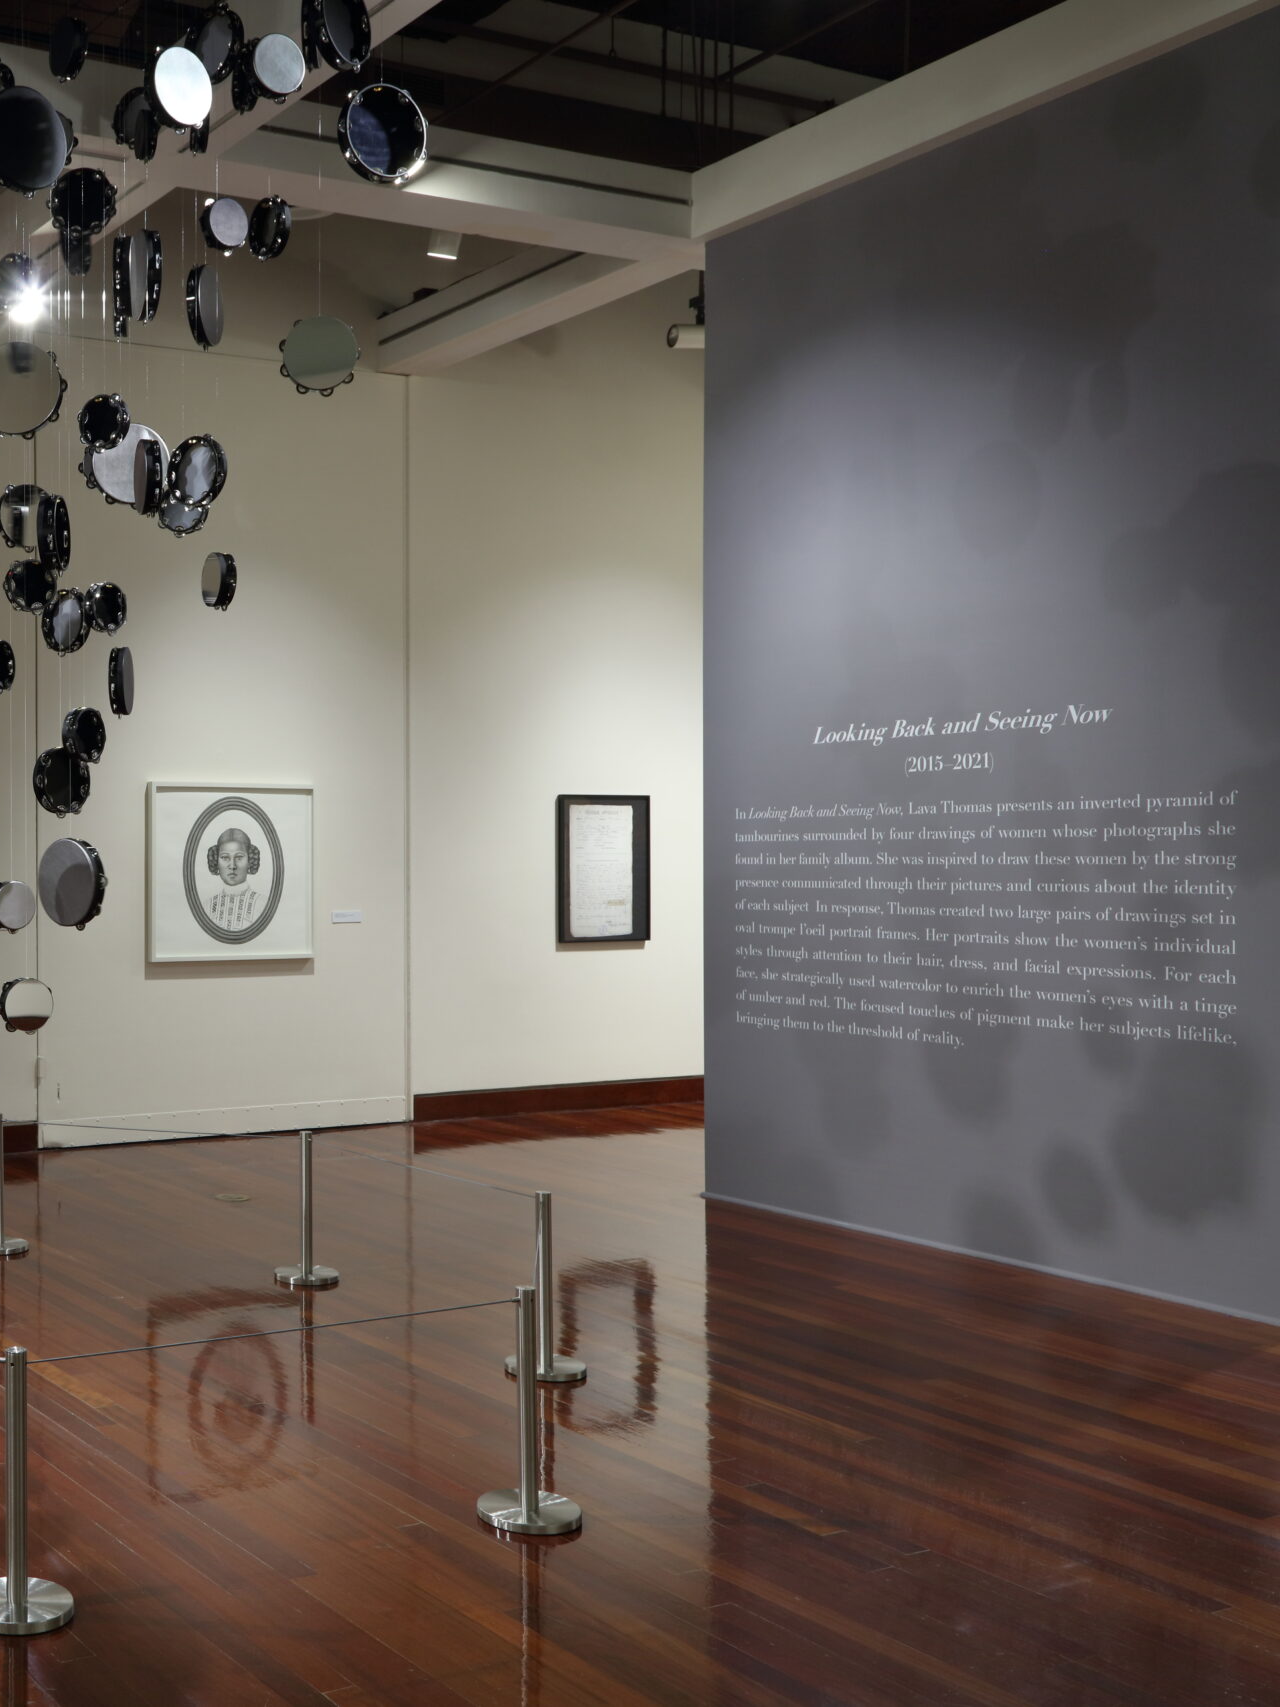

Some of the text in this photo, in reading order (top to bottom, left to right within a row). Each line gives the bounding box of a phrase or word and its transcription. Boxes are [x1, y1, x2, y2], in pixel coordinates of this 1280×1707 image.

[813, 704, 1114, 746] Looking Back and Seeing Now
[735, 808, 746, 819] In
[748, 807, 789, 821] Looking
[790, 805, 814, 818] Back
[816, 804, 837, 816] and
[839, 804, 874, 819] Seeing
[908, 802, 937, 814] Lava
[940, 800, 992, 813] Thomas
[996, 800, 1053, 816] presents
[1057, 801, 1075, 810] an
[1079, 794, 1142, 809] inverted
[1146, 791, 1213, 812] pyramid
[1219, 790, 1238, 805] of
[735, 821, 1236, 844] tambourines surrounded by four drawings of women whose photographs she
[735, 853, 763, 864] found
[766, 853, 776, 864] in
[780, 853, 796, 864] her
[799, 853, 831, 868] family
[834, 852, 872, 864] album.
[876, 852, 898, 864] She
[927, 852, 977, 869] inspired
[981, 855, 994, 864] to
[998, 851, 1031, 864] draw
[1035, 851, 1070, 864] these
[1074, 856, 1126, 864] women
[1132, 851, 1150, 869] by
[1154, 851, 1179, 864] the
[1185, 853, 1239, 870] strong
[736, 877, 1237, 899] presence communicated through their pictures and curious about the identity
[735, 899, 746, 910] of
[747, 899, 771, 910] each
[815, 900, 827, 912] In
[830, 905, 883, 917] response,
[887, 902, 935, 915] Thomas
[938, 904, 985, 917] created
[988, 907, 1013, 917] two
[1017, 905, 1051, 923] large
[1056, 906, 1091, 924] pairs
[1095, 907, 1112, 920] of
[1115, 908, 1186, 927] drawings
[1191, 913, 1214, 924] set
[1219, 910, 1236, 924] in
[736, 922, 754, 933] oval
[759, 924, 795, 938] trompe
[830, 926, 871, 940] portrait
[877, 926, 920, 940] frames.
[926, 928, 949, 941] Her
[954, 931, 1009, 946] portraits
[1015, 932, 1049, 946] show
[1056, 933, 1078, 947] the
[1154, 937, 1235, 954] individual
[736, 944, 1237, 984] styles through attention to their hair, dress, and facial expressions. For each
[736, 967, 758, 979] face,
[762, 968, 778, 980] she
[781, 972, 845, 989] strategically
[849, 975, 875, 987] used
[880, 979, 942, 992] watercolor
[946, 983, 958, 993] to
[963, 983, 1004, 997] enrich
[1010, 985, 1031, 998] the
[1102, 997, 1133, 1009] eyes
[1138, 995, 1174, 1009] with
[1180, 1002, 1188, 1010] a
[1195, 998, 1237, 1018] tinge
[735, 990, 1237, 1044] of umber and red. The focused touches of pigment make her subjects lifelike,
[736, 1011, 964, 1049] bringing them to the threshold of reality.
